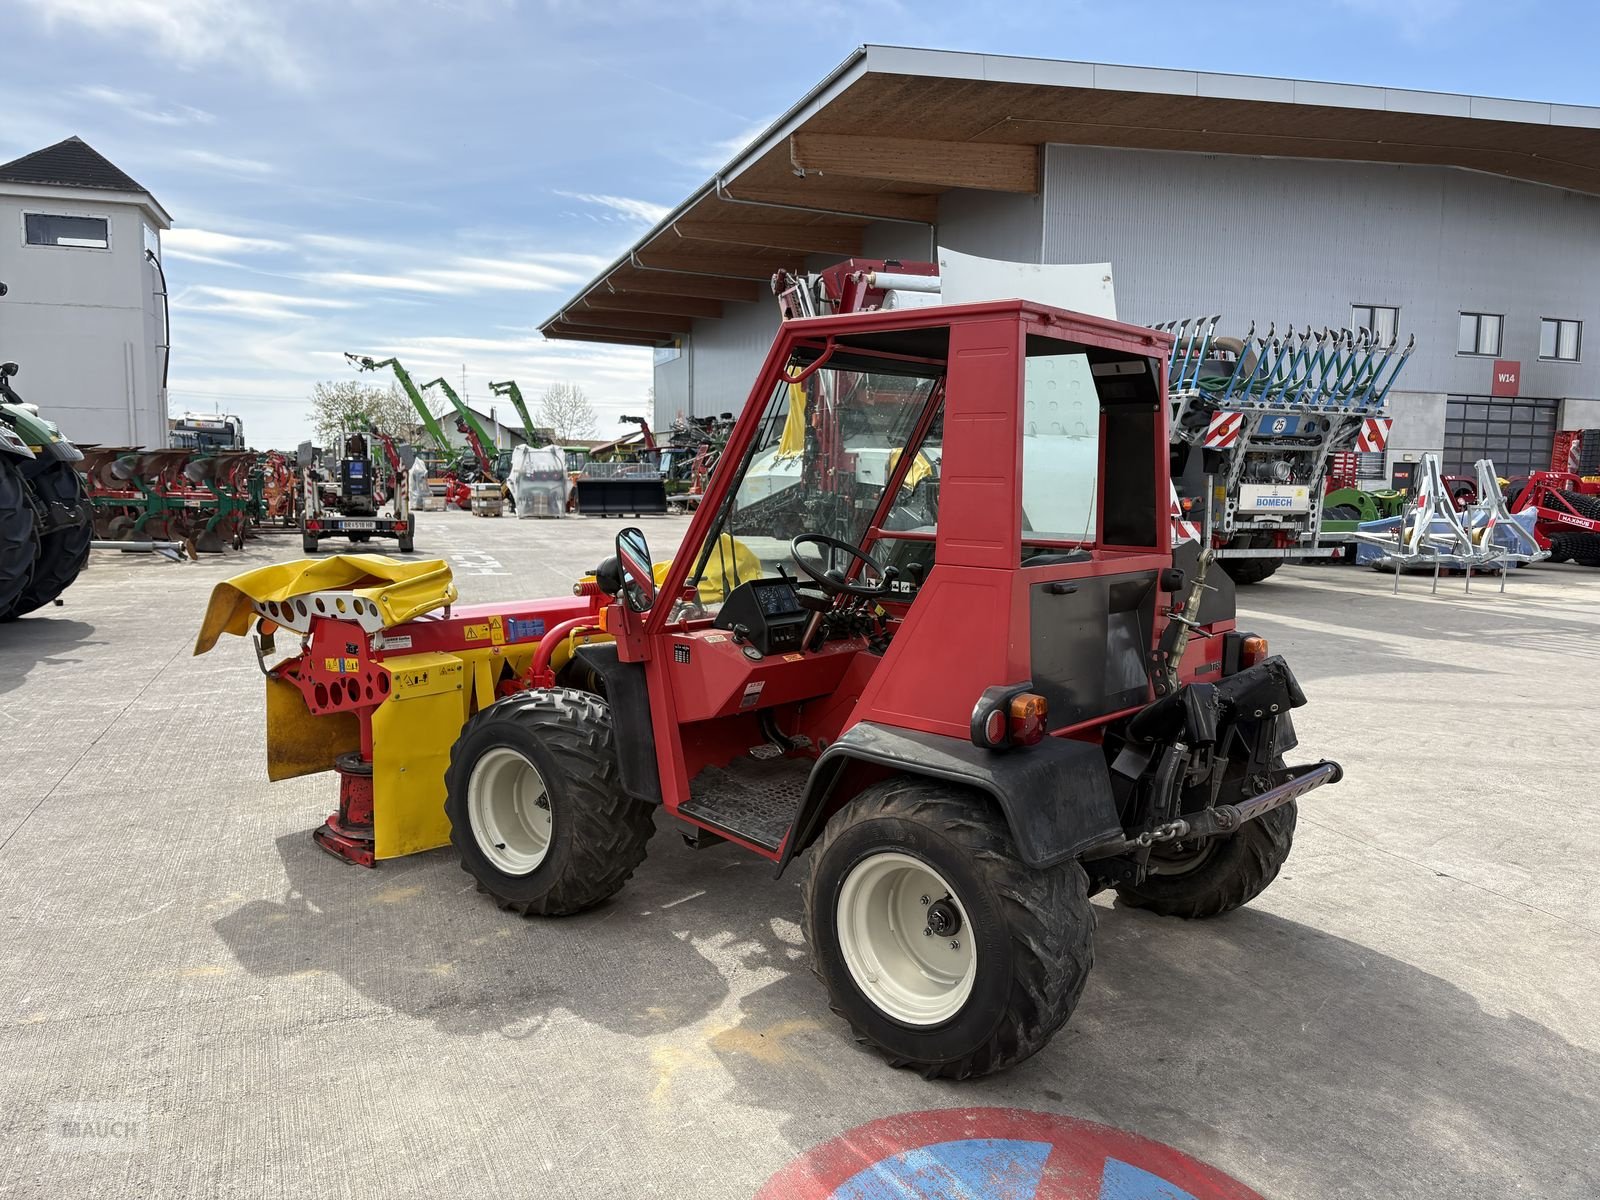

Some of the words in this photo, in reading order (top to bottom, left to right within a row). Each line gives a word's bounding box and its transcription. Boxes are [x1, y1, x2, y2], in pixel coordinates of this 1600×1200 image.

[1498, 373, 1515, 383] W14
[1274, 420, 1285, 431] 25
[1256, 498, 1293, 507] BOMECH
